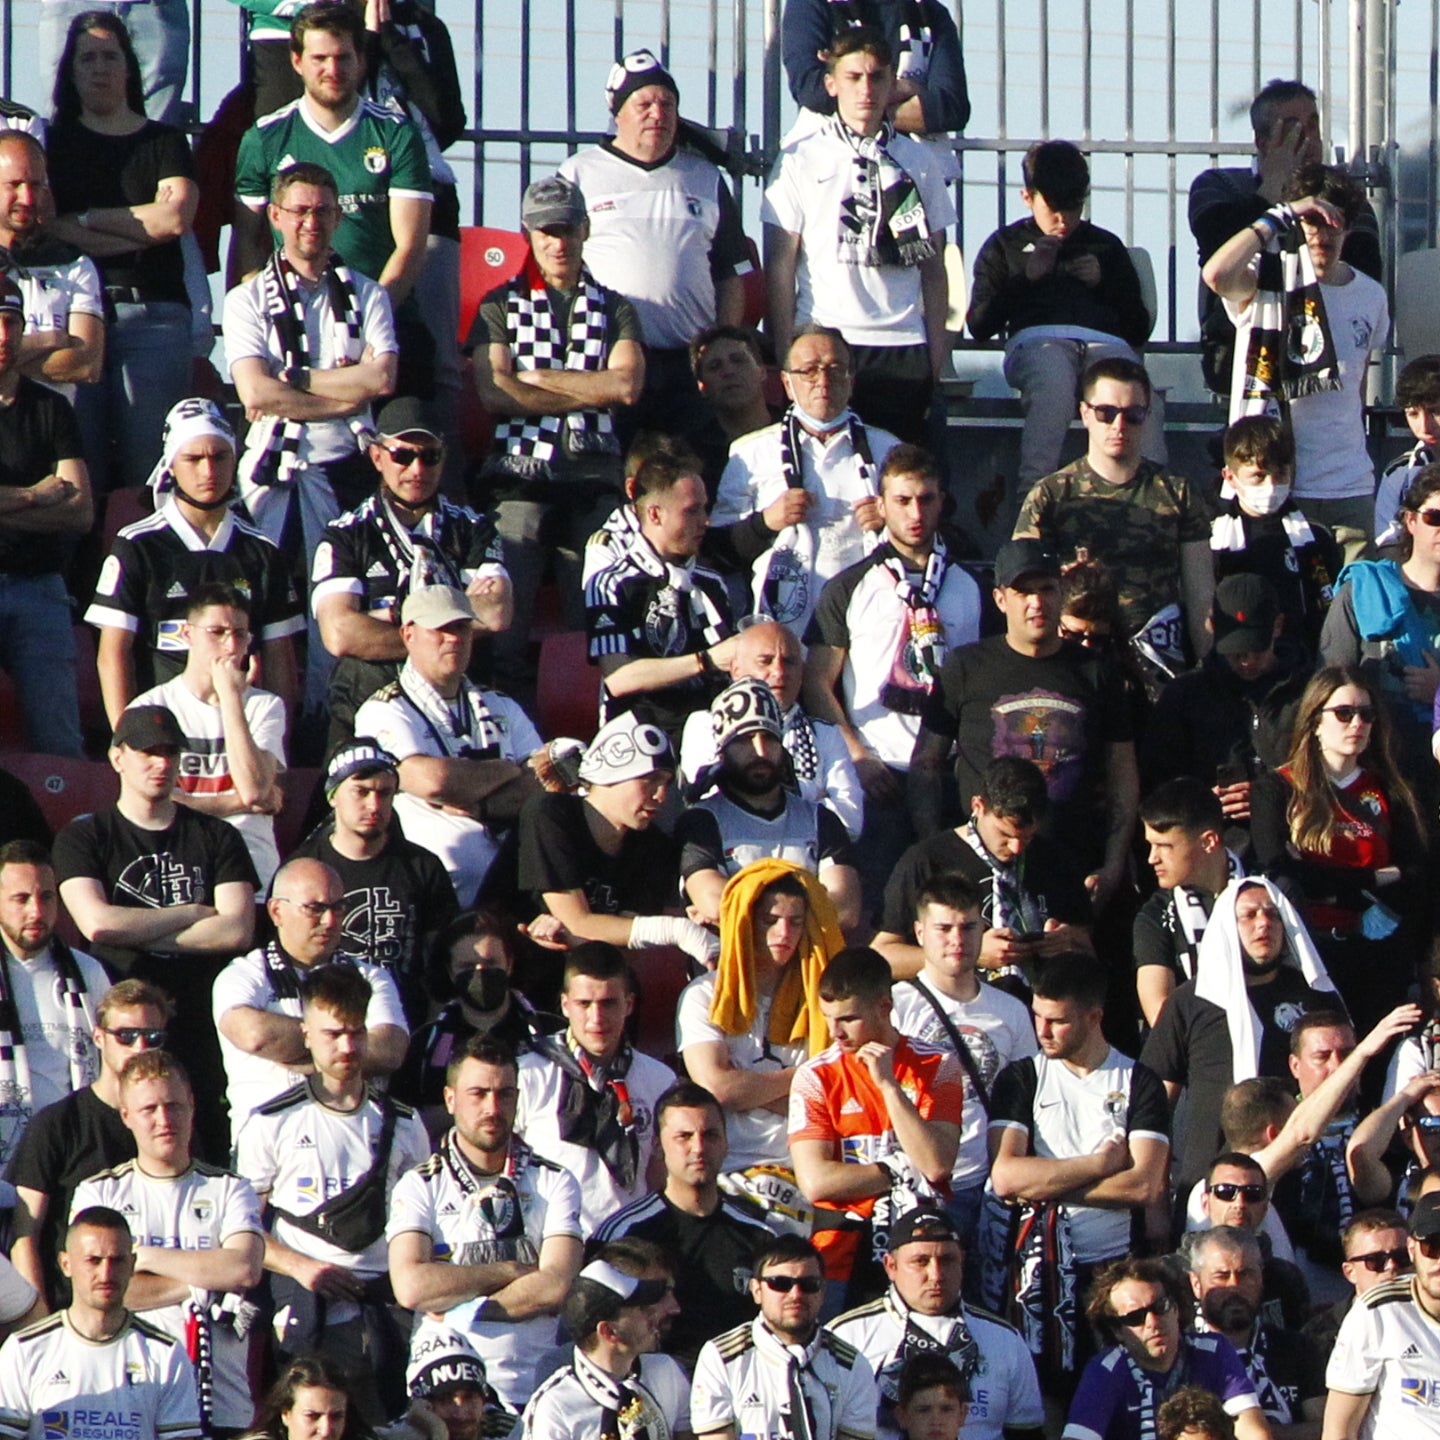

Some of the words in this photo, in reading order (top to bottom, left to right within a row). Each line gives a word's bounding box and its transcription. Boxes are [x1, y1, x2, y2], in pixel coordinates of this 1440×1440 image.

[487, 251, 501, 262] 50
[73, 1409, 142, 1428] REALE
[72, 1427, 141, 1440] SEGUROS
